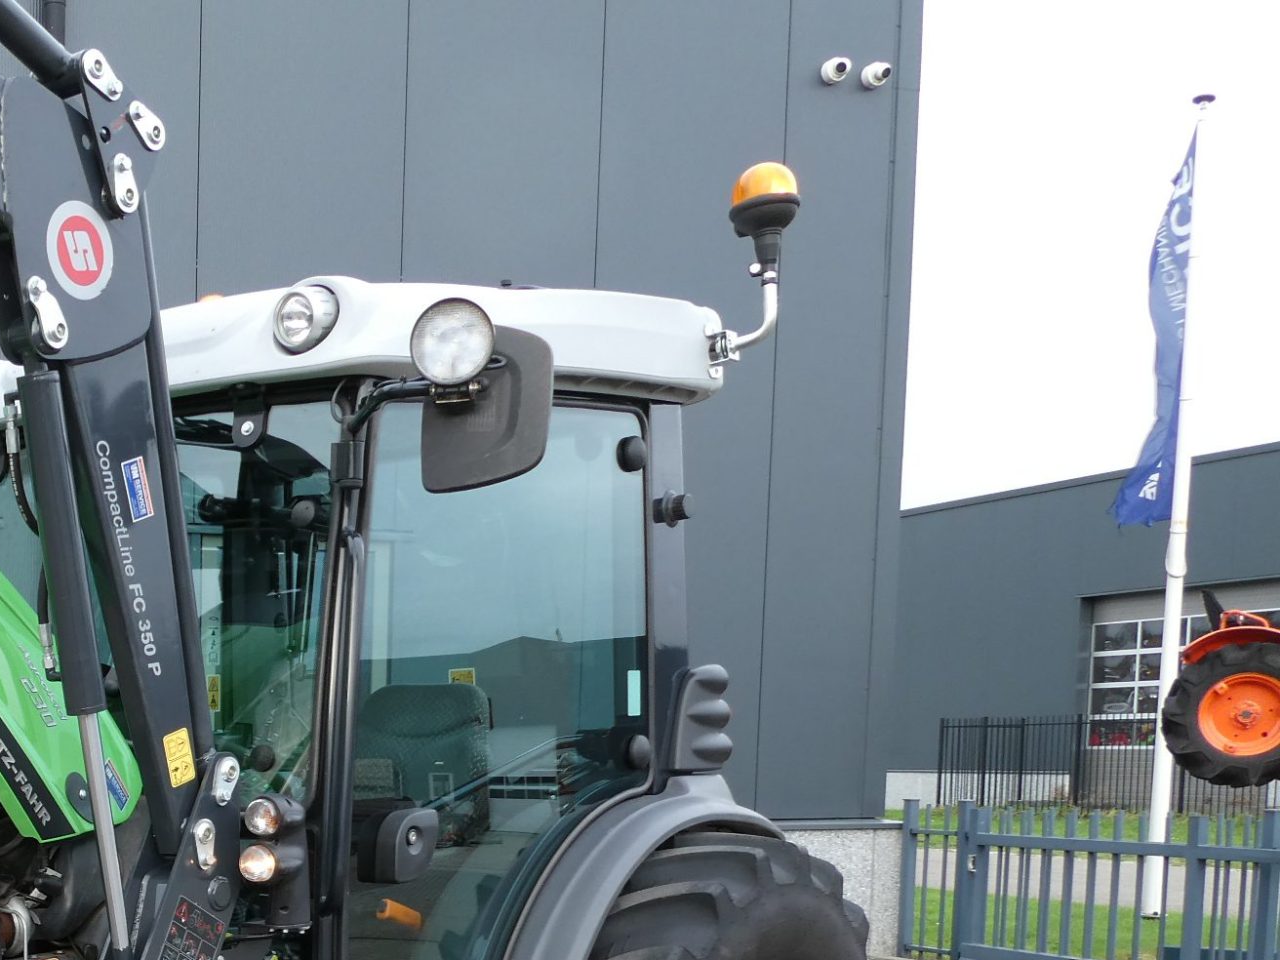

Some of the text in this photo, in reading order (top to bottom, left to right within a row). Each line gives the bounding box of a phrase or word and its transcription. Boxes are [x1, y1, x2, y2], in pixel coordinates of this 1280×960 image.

[130, 462, 140, 480] VM
[134, 479, 148, 516] SERVICE
[96, 440, 136, 577] CompactLine
[129, 583, 146, 614] FC
[138, 619, 157, 657] 350
[148, 662, 162, 677] P
